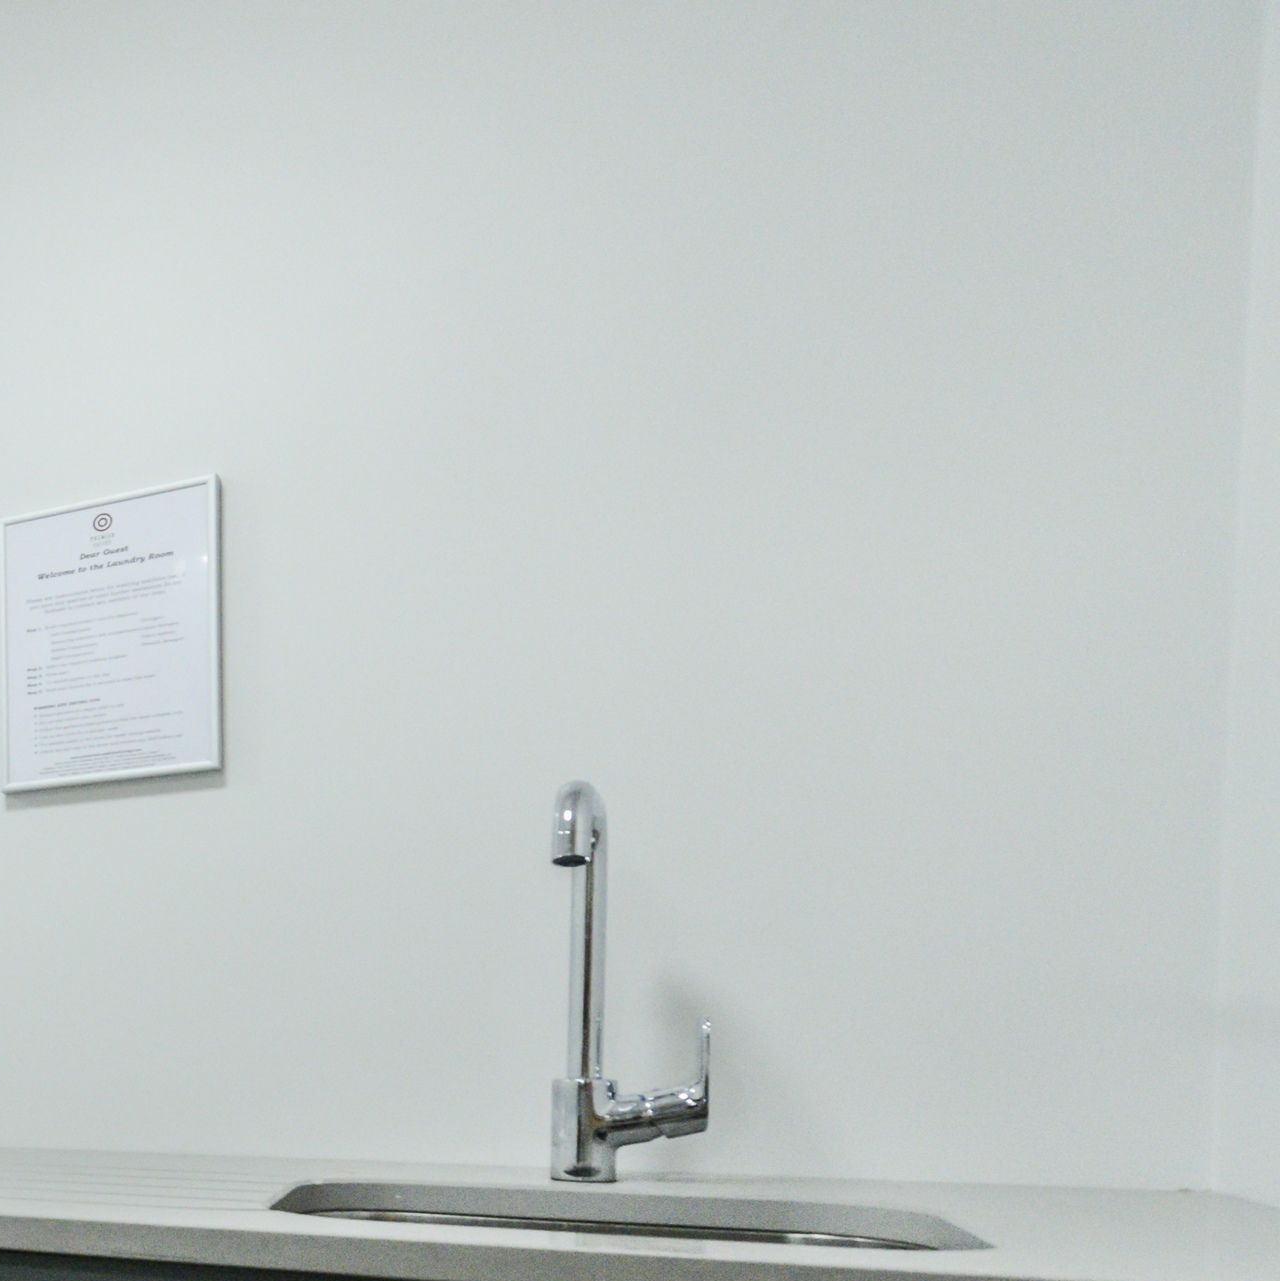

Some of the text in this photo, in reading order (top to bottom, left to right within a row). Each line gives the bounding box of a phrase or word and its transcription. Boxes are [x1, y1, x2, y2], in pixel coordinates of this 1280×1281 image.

[80, 545, 129, 560] Dear Guest
[37, 550, 174, 580] Welcome to the Laundry Room
